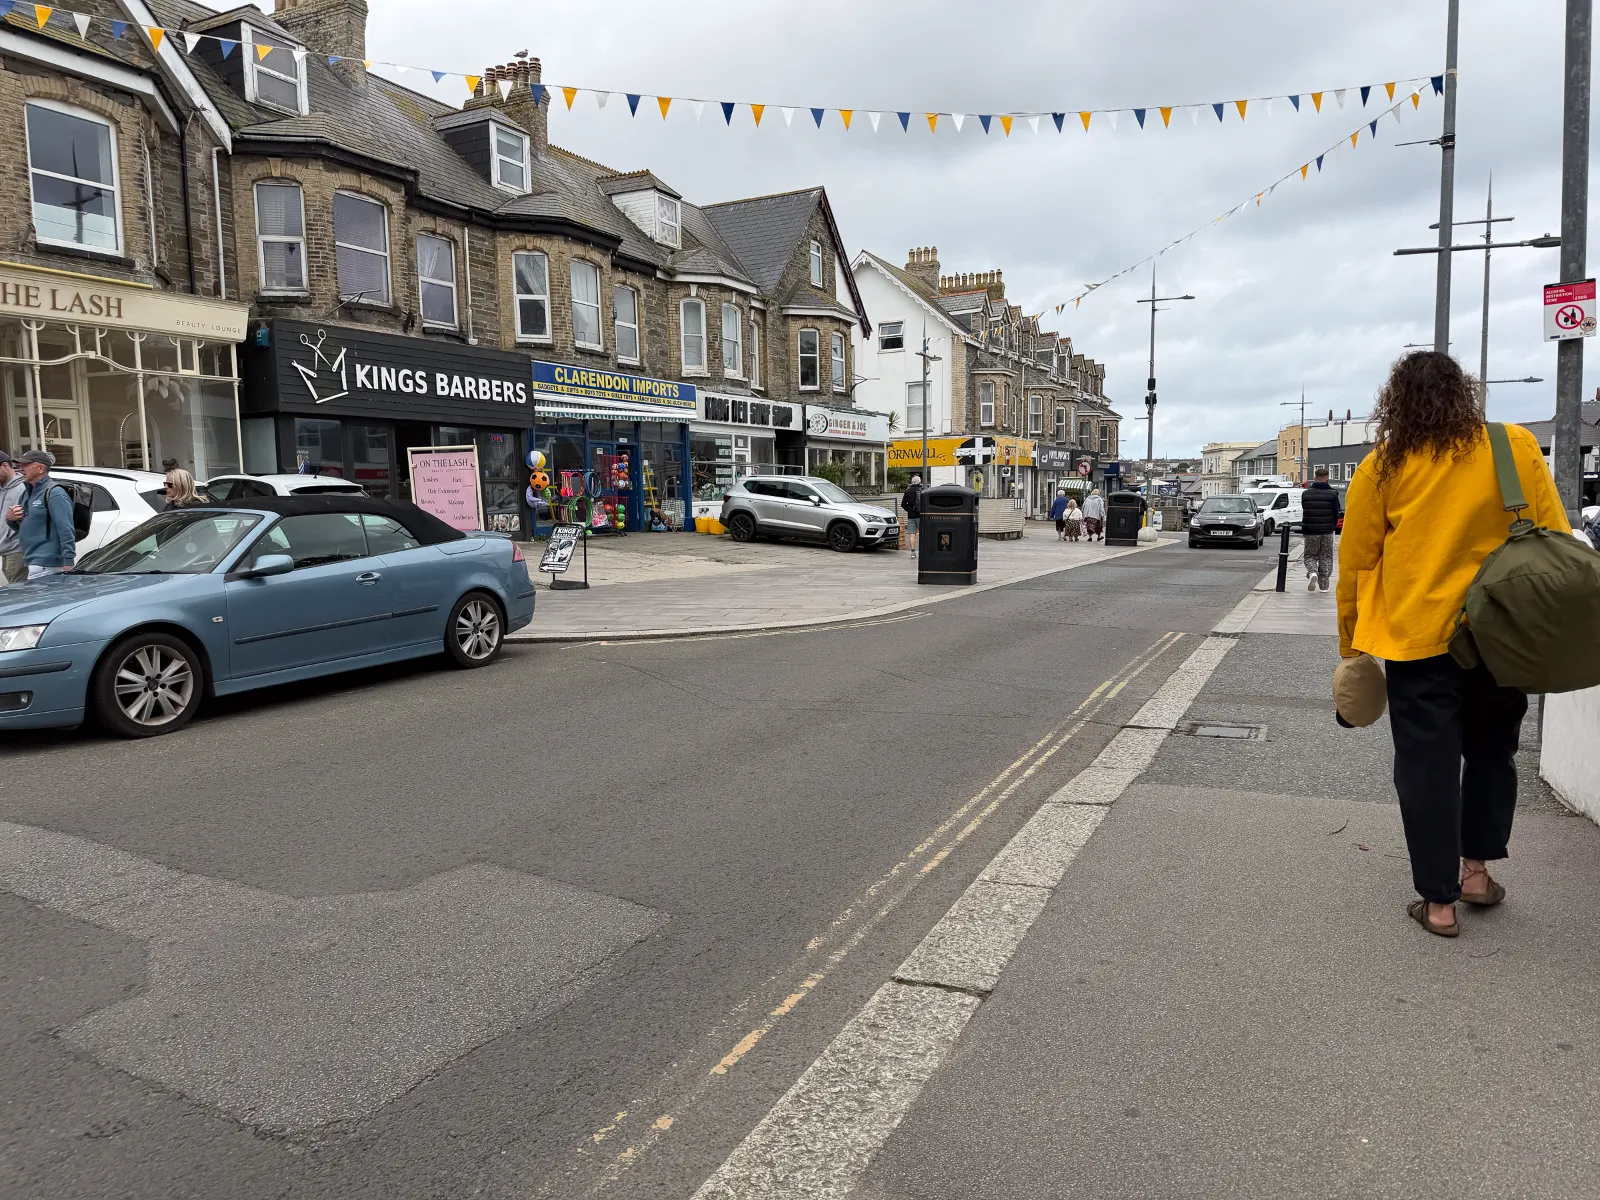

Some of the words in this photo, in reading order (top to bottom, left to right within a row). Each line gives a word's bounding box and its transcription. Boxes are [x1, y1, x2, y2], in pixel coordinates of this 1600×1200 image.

[0, 281, 41, 308] HE
[50, 288, 123, 318] LASH
[1545, 291, 1573, 299] RESTRICTION
[176, 319, 206, 329] BEAUTY
[211, 324, 241, 334] LOUNGE
[355, 363, 428, 394] KINGS
[435, 372, 527, 404] BARBERS
[537, 382, 559, 392] GADGETS
[554, 367, 630, 391] CLARENDON
[632, 378, 680, 398] IMPORTS
[828, 418, 851, 430] GINGER
[852, 420, 856, 430] &
[857, 421, 867, 431] JOE
[888, 447, 936, 460] ORNWLL
[419, 459, 431, 468] ON
[432, 458, 448, 468] THE
[448, 458, 468, 468] LASH
